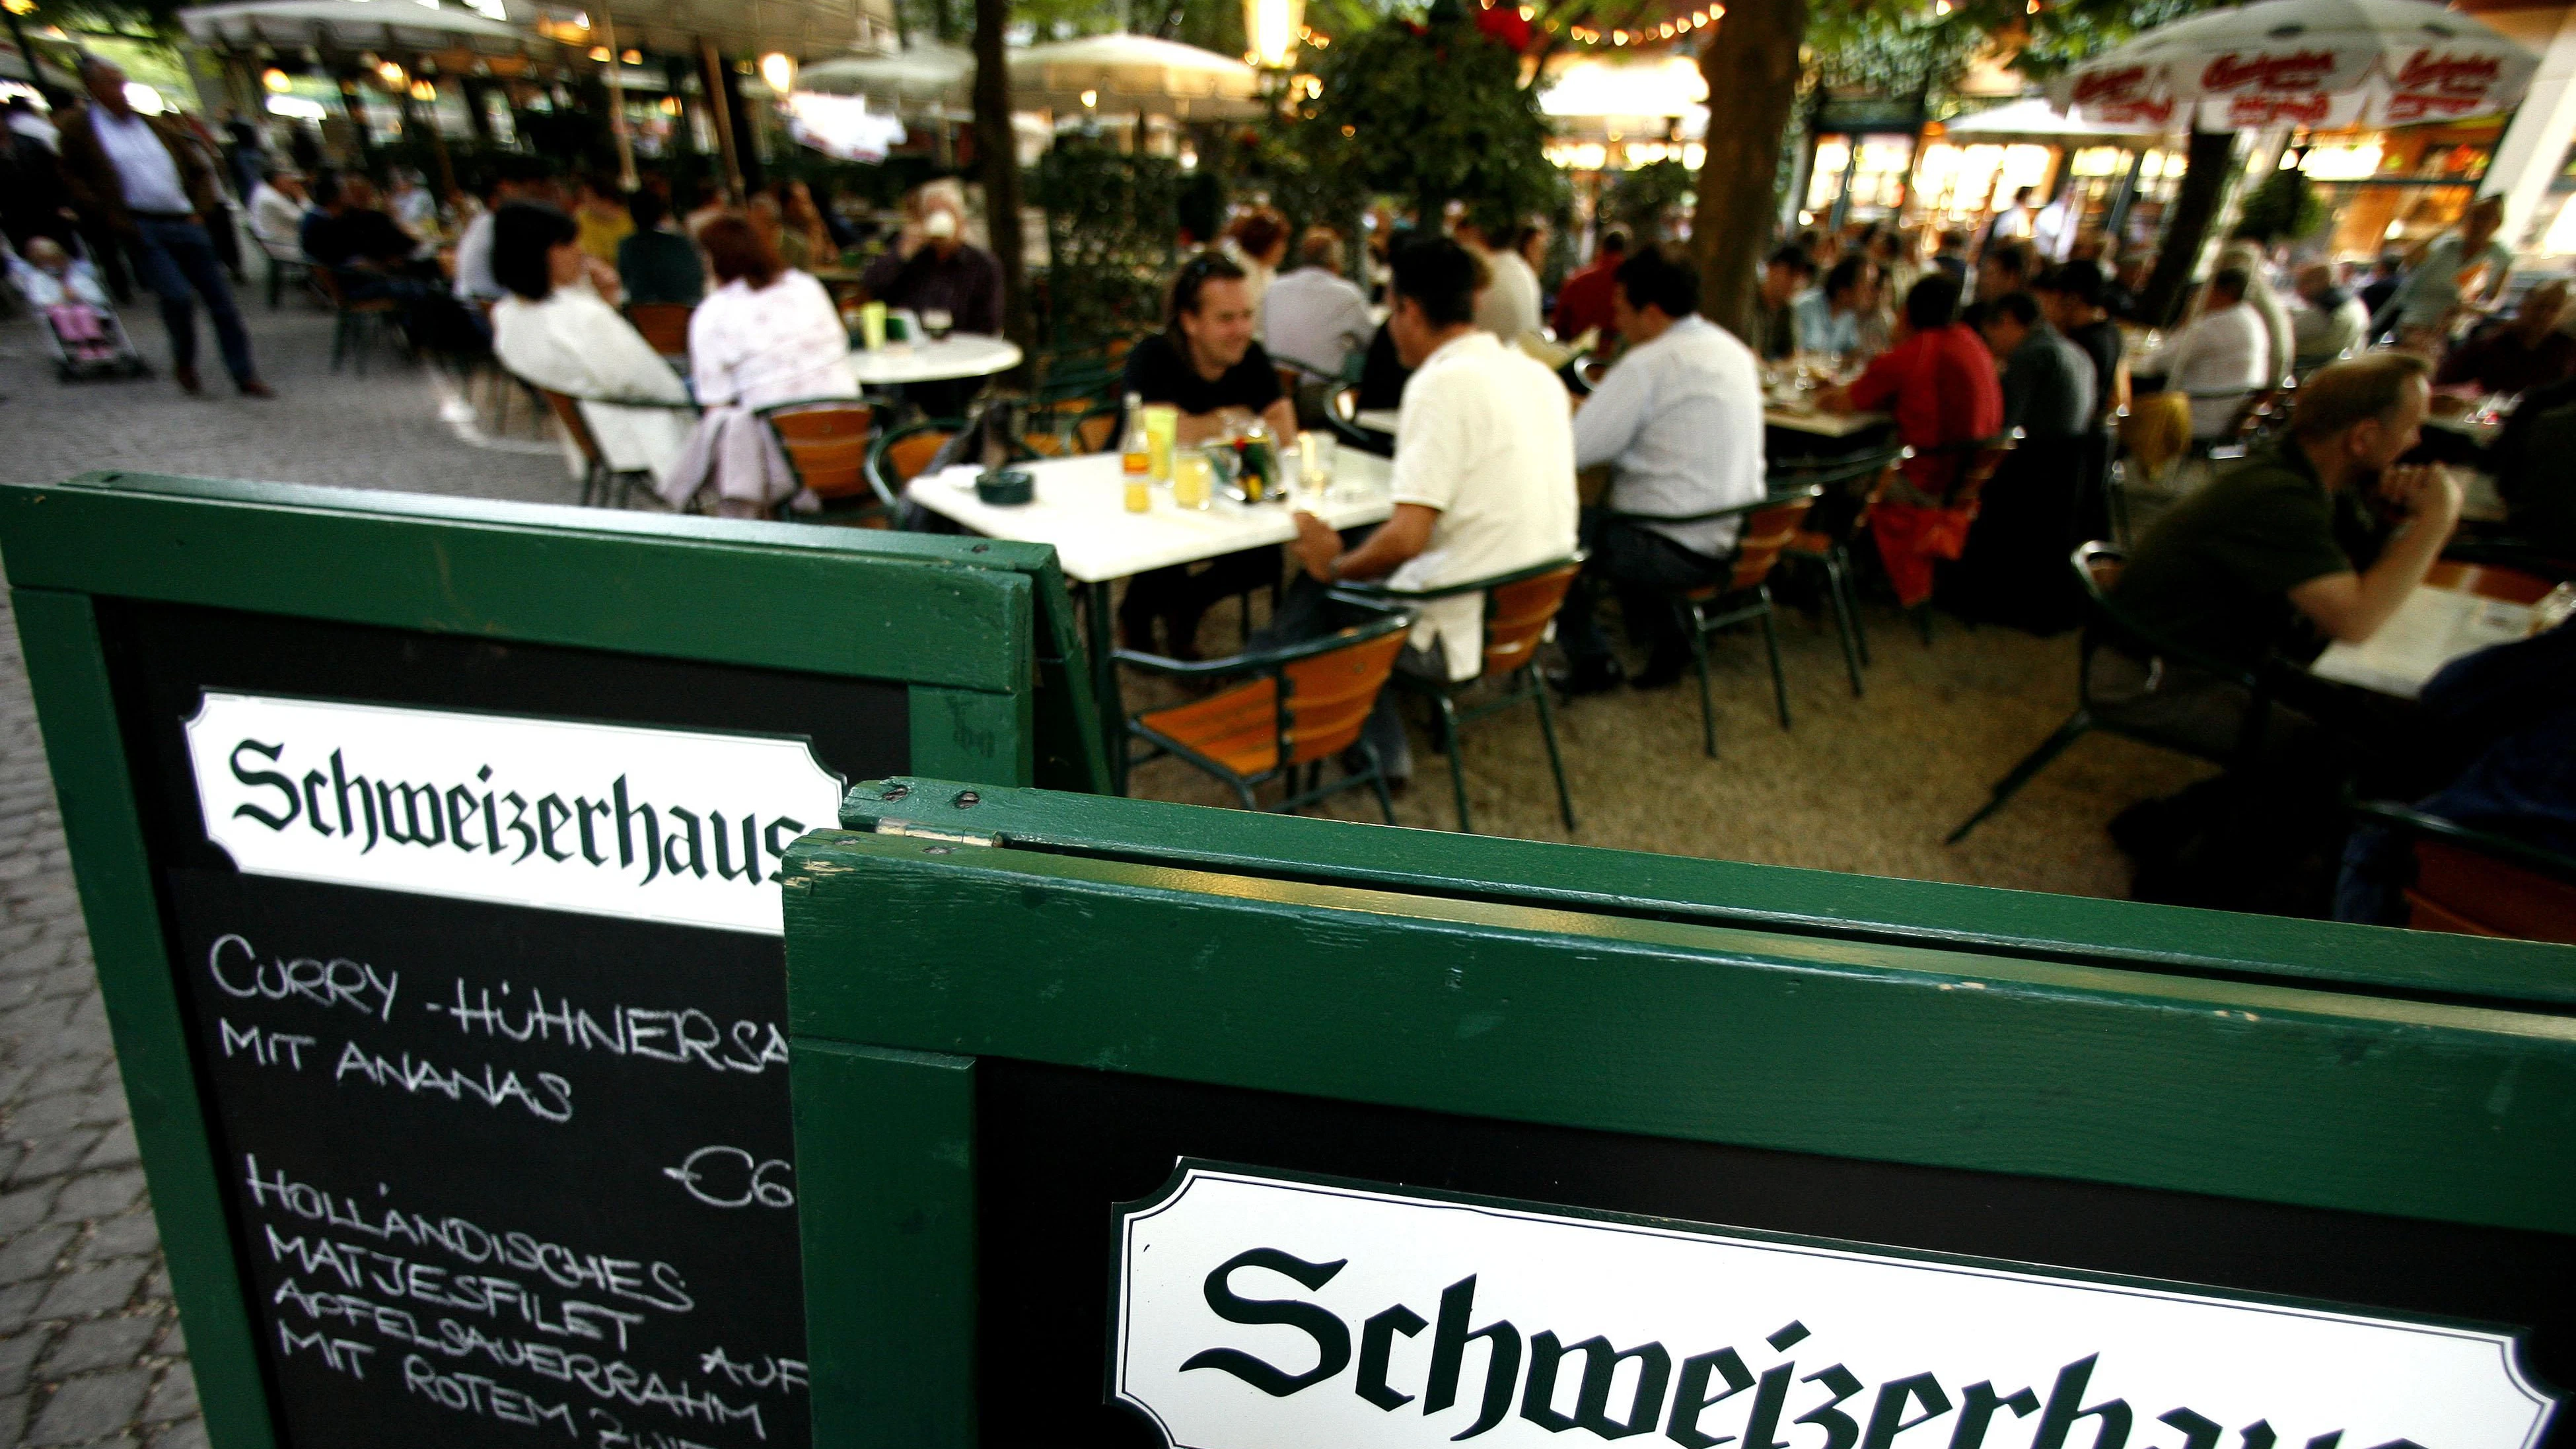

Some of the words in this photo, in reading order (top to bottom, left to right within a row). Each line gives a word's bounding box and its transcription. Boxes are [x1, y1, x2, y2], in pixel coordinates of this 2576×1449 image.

[229, 738, 806, 887] Schweizerhaus
[220, 1019, 316, 1071] MIT
[336, 1042, 572, 1123] ANANAS
[266, 1224, 644, 1351] MATJESFILET
[700, 1346, 808, 1394] AUF
[278, 1319, 375, 1380] MIT
[404, 1354, 578, 1438] ROTEM
[1180, 1247, 2431, 1449] Schweizerh
